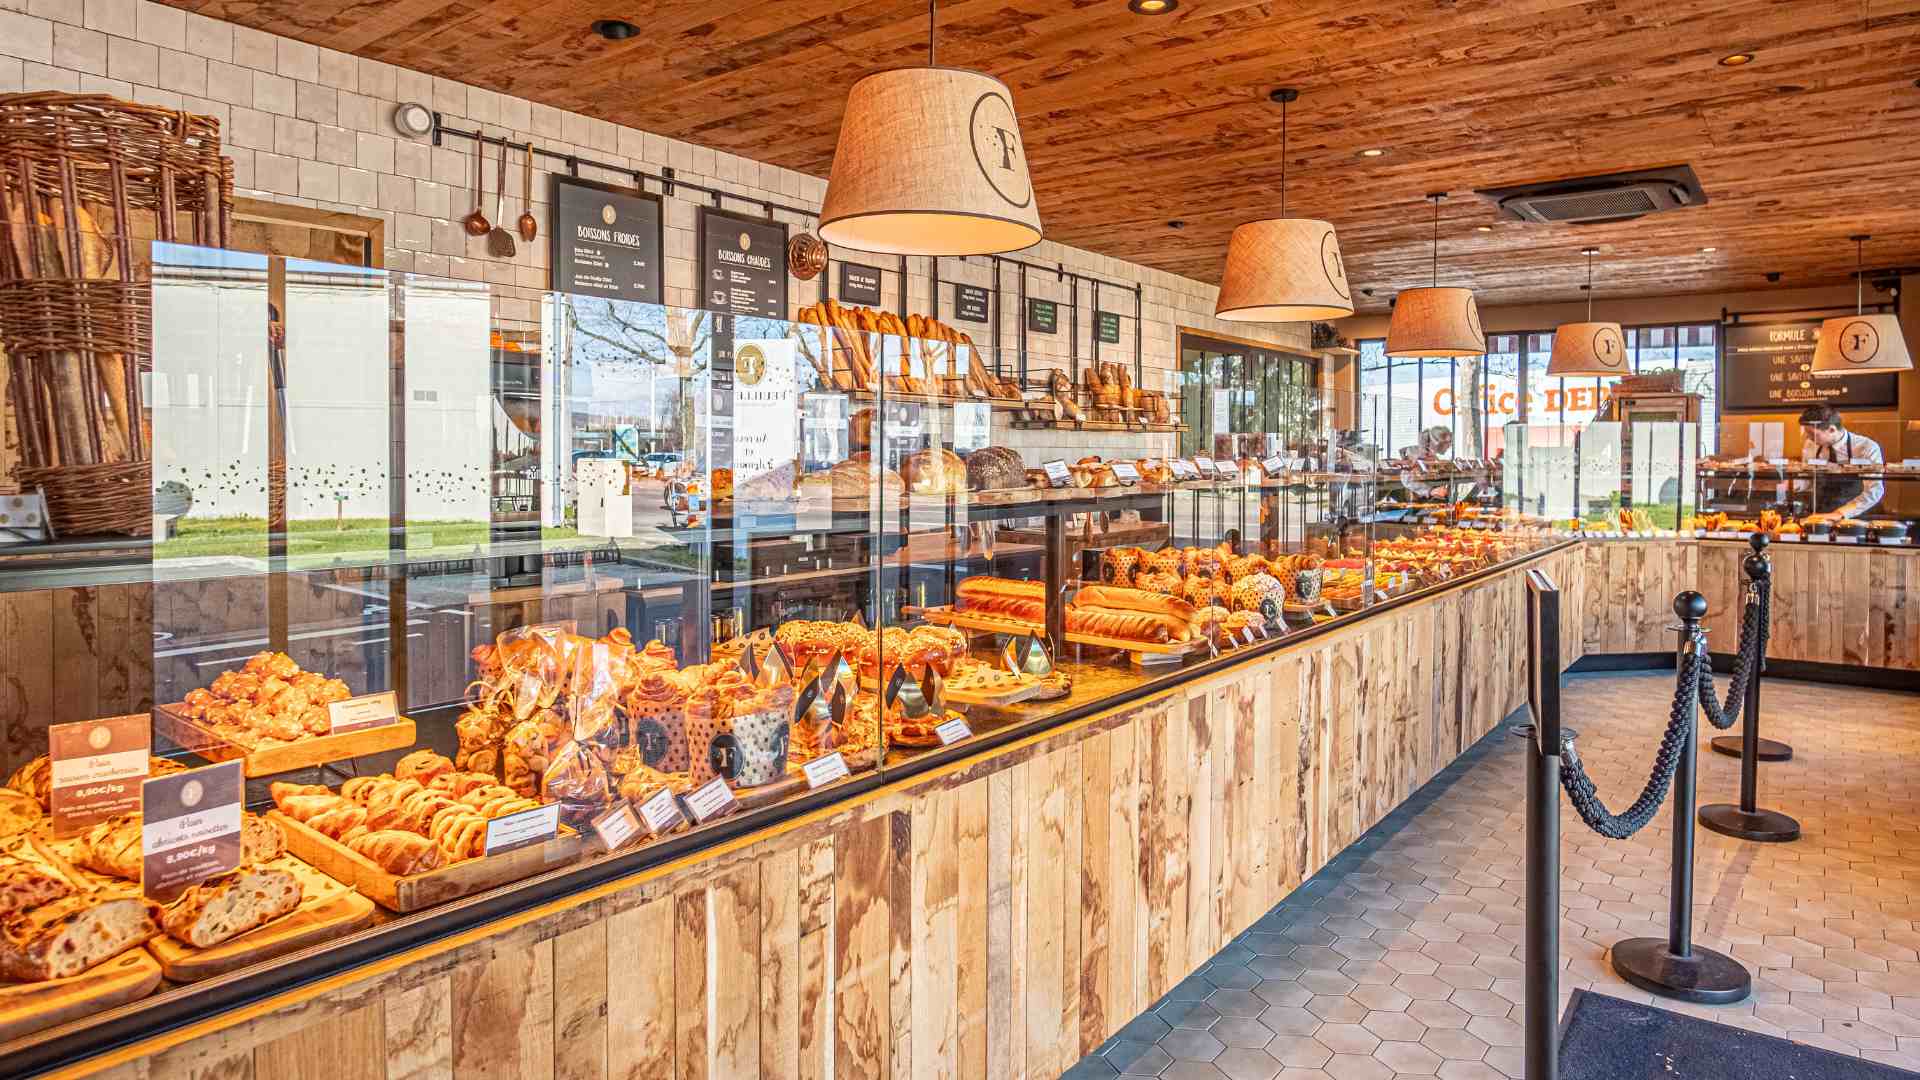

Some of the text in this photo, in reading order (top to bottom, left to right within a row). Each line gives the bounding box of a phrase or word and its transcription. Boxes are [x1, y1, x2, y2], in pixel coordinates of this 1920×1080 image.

[991, 125, 1017, 172] F
[577, 225, 640, 247] BOISSONS FROIDES
[718, 249, 745, 263] BOISSONS
[1851, 333, 1870, 351] F
